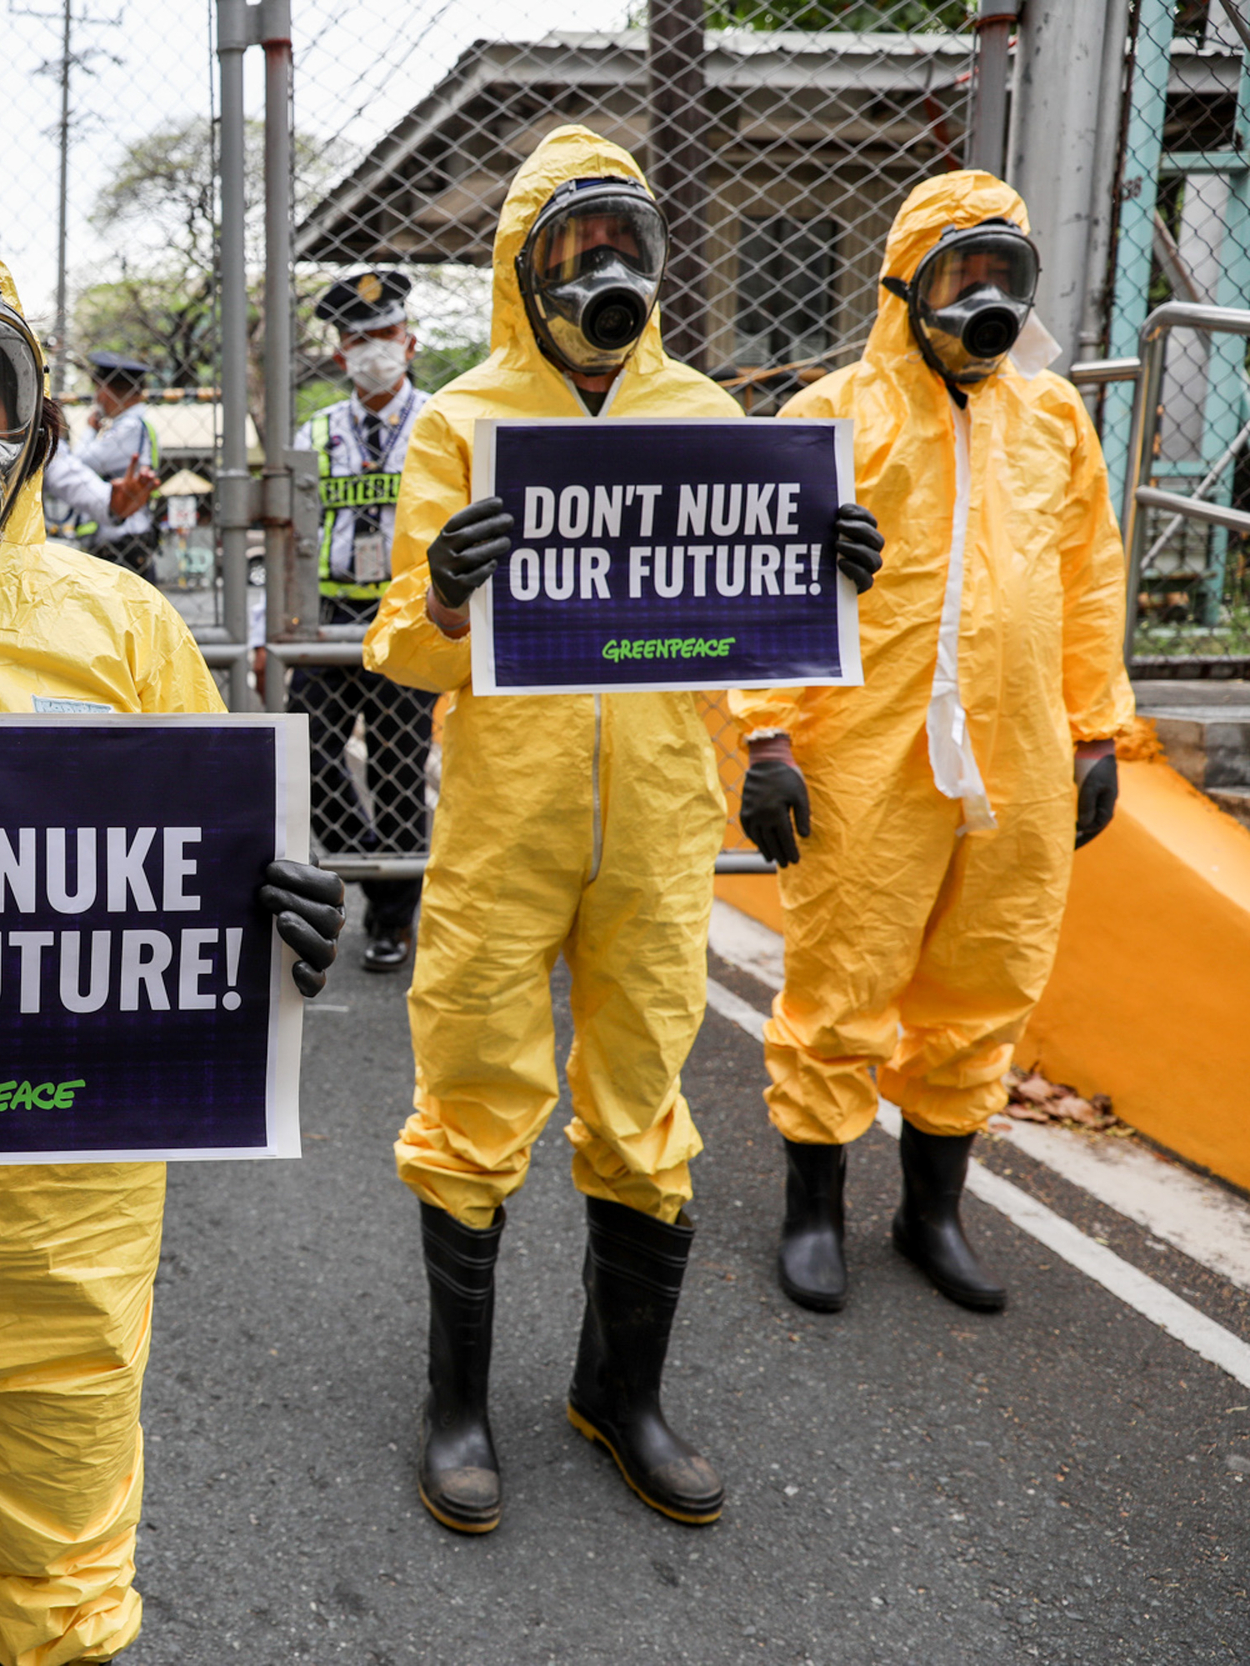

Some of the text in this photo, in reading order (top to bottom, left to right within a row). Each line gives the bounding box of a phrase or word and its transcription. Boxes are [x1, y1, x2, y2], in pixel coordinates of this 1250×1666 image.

[524, 483, 801, 539] DON'T NUKE
[510, 544, 822, 601] OUR FUTURE!
[603, 638, 735, 662] GREENPEACE
